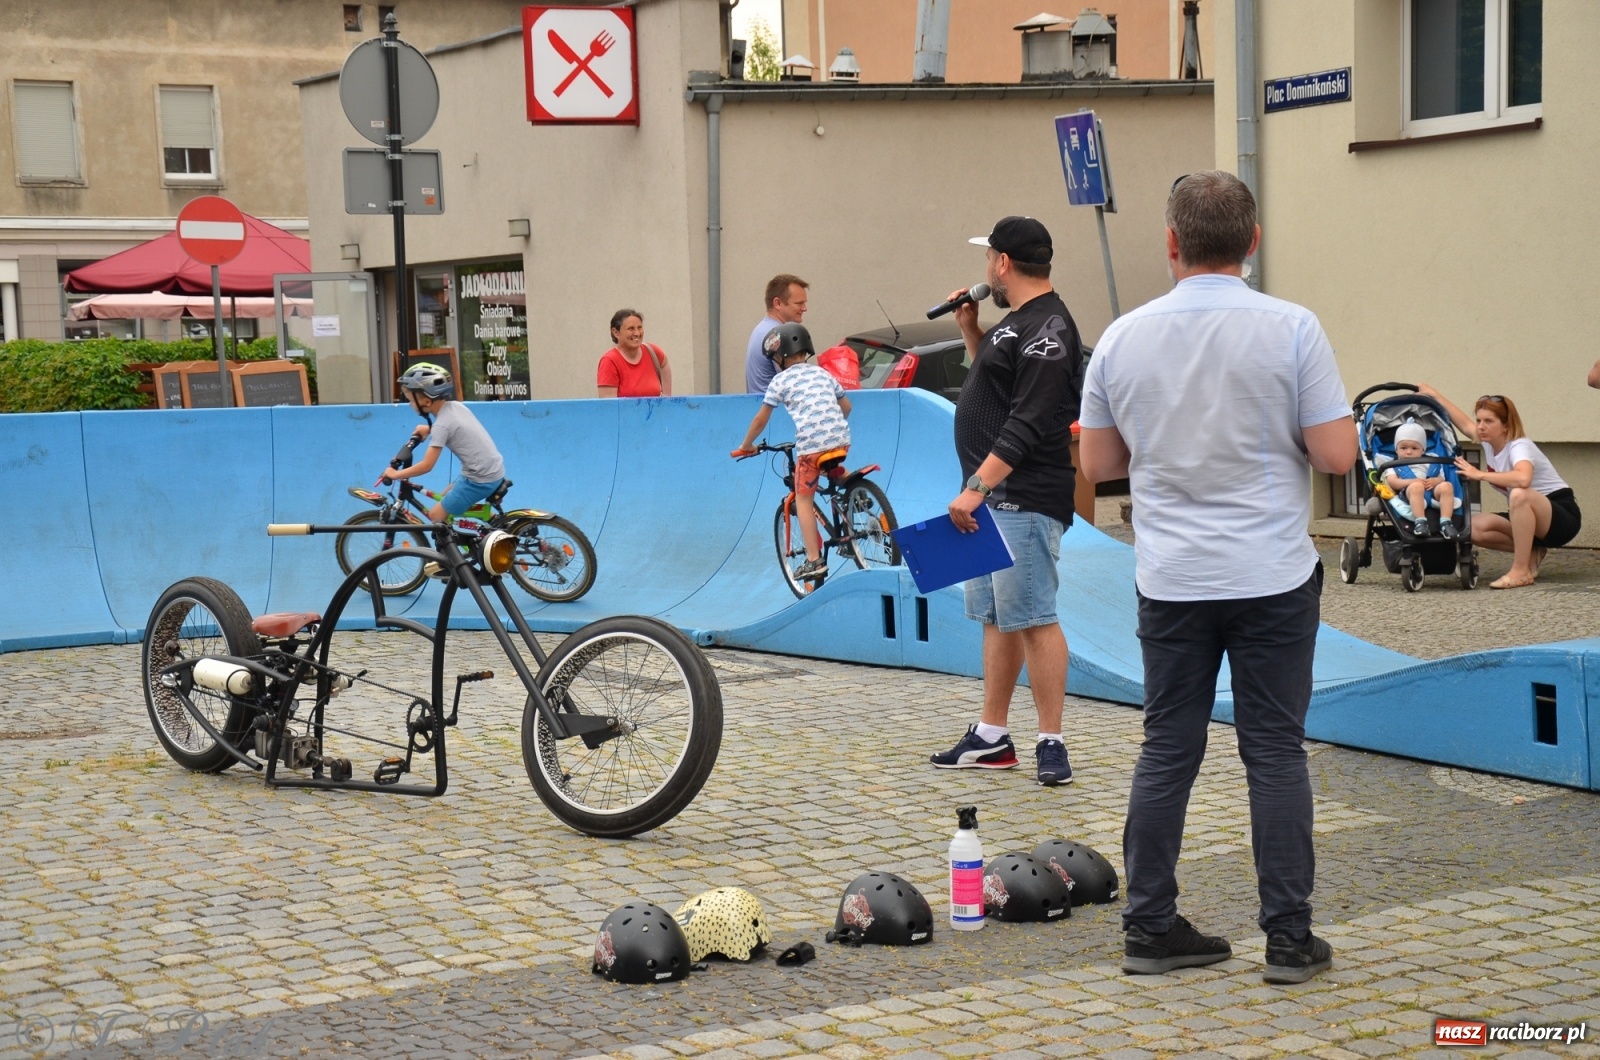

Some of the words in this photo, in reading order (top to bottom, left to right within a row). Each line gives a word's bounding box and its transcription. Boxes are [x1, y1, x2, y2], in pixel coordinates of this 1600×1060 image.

[1267, 86, 1285, 105] Plac
[1286, 73, 1346, 101] Dominikański
[461, 271, 526, 299] JADŁODAJNI
[480, 300, 513, 319] Śniadania
[474, 323, 494, 339] Dania
[495, 322, 521, 338] barowe
[489, 342, 507, 361] Zupy
[486, 361, 512, 380] Obiady
[474, 380, 494, 395] Dania
[494, 383, 505, 395] na
[504, 383, 527, 399] wynos
